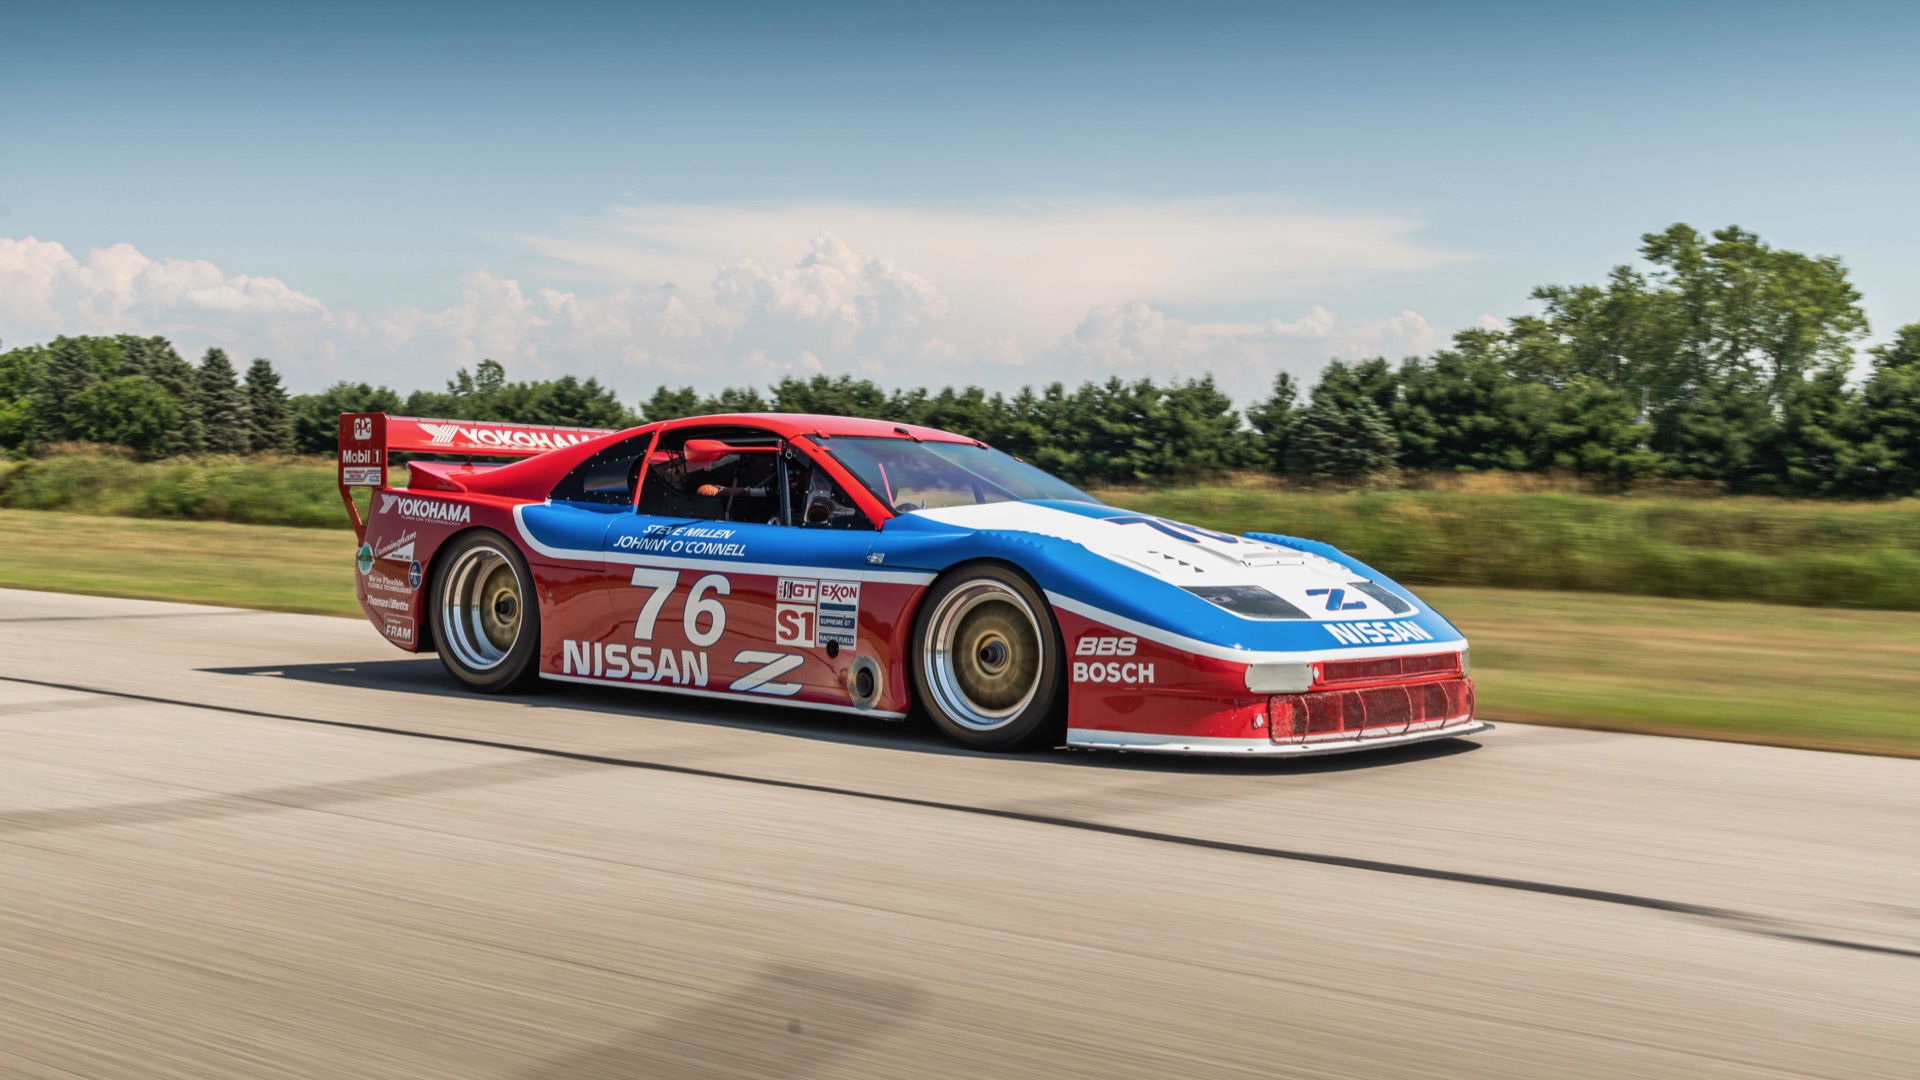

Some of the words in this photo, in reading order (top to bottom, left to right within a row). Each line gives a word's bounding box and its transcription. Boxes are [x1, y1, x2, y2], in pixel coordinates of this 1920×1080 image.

[355, 417, 371, 436] PPG
[342, 449, 371, 464] Mobil
[397, 498, 470, 523] YOKOHAMA
[424, 518, 461, 526] TECHNOLOGY
[643, 525, 686, 536] STEVE
[684, 528, 735, 539] MILLEN
[614, 536, 671, 551] JOHNNY
[670, 541, 746, 556] O'CONNELL
[368, 574, 382, 582] We're
[368, 582, 383, 590] FLEXIBLE
[383, 585, 412, 594] TECHNOLOGIES
[792, 584, 816, 598] GT
[821, 584, 857, 602] EXXON
[366, 595, 388, 608] Thomas
[391, 600, 409, 611] Betts
[630, 567, 731, 647] 76
[1305, 589, 1367, 611] Z
[778, 609, 814, 641] S1
[820, 618, 843, 626] SUPREME
[386, 625, 411, 639] FRAM
[839, 636, 854, 644] FUELS
[1322, 621, 1434, 645] NISSAN
[1075, 637, 1138, 656] BBS
[563, 639, 708, 687] NISSAN
[729, 650, 804, 696] Z
[1073, 662, 1154, 683] BOSCH
